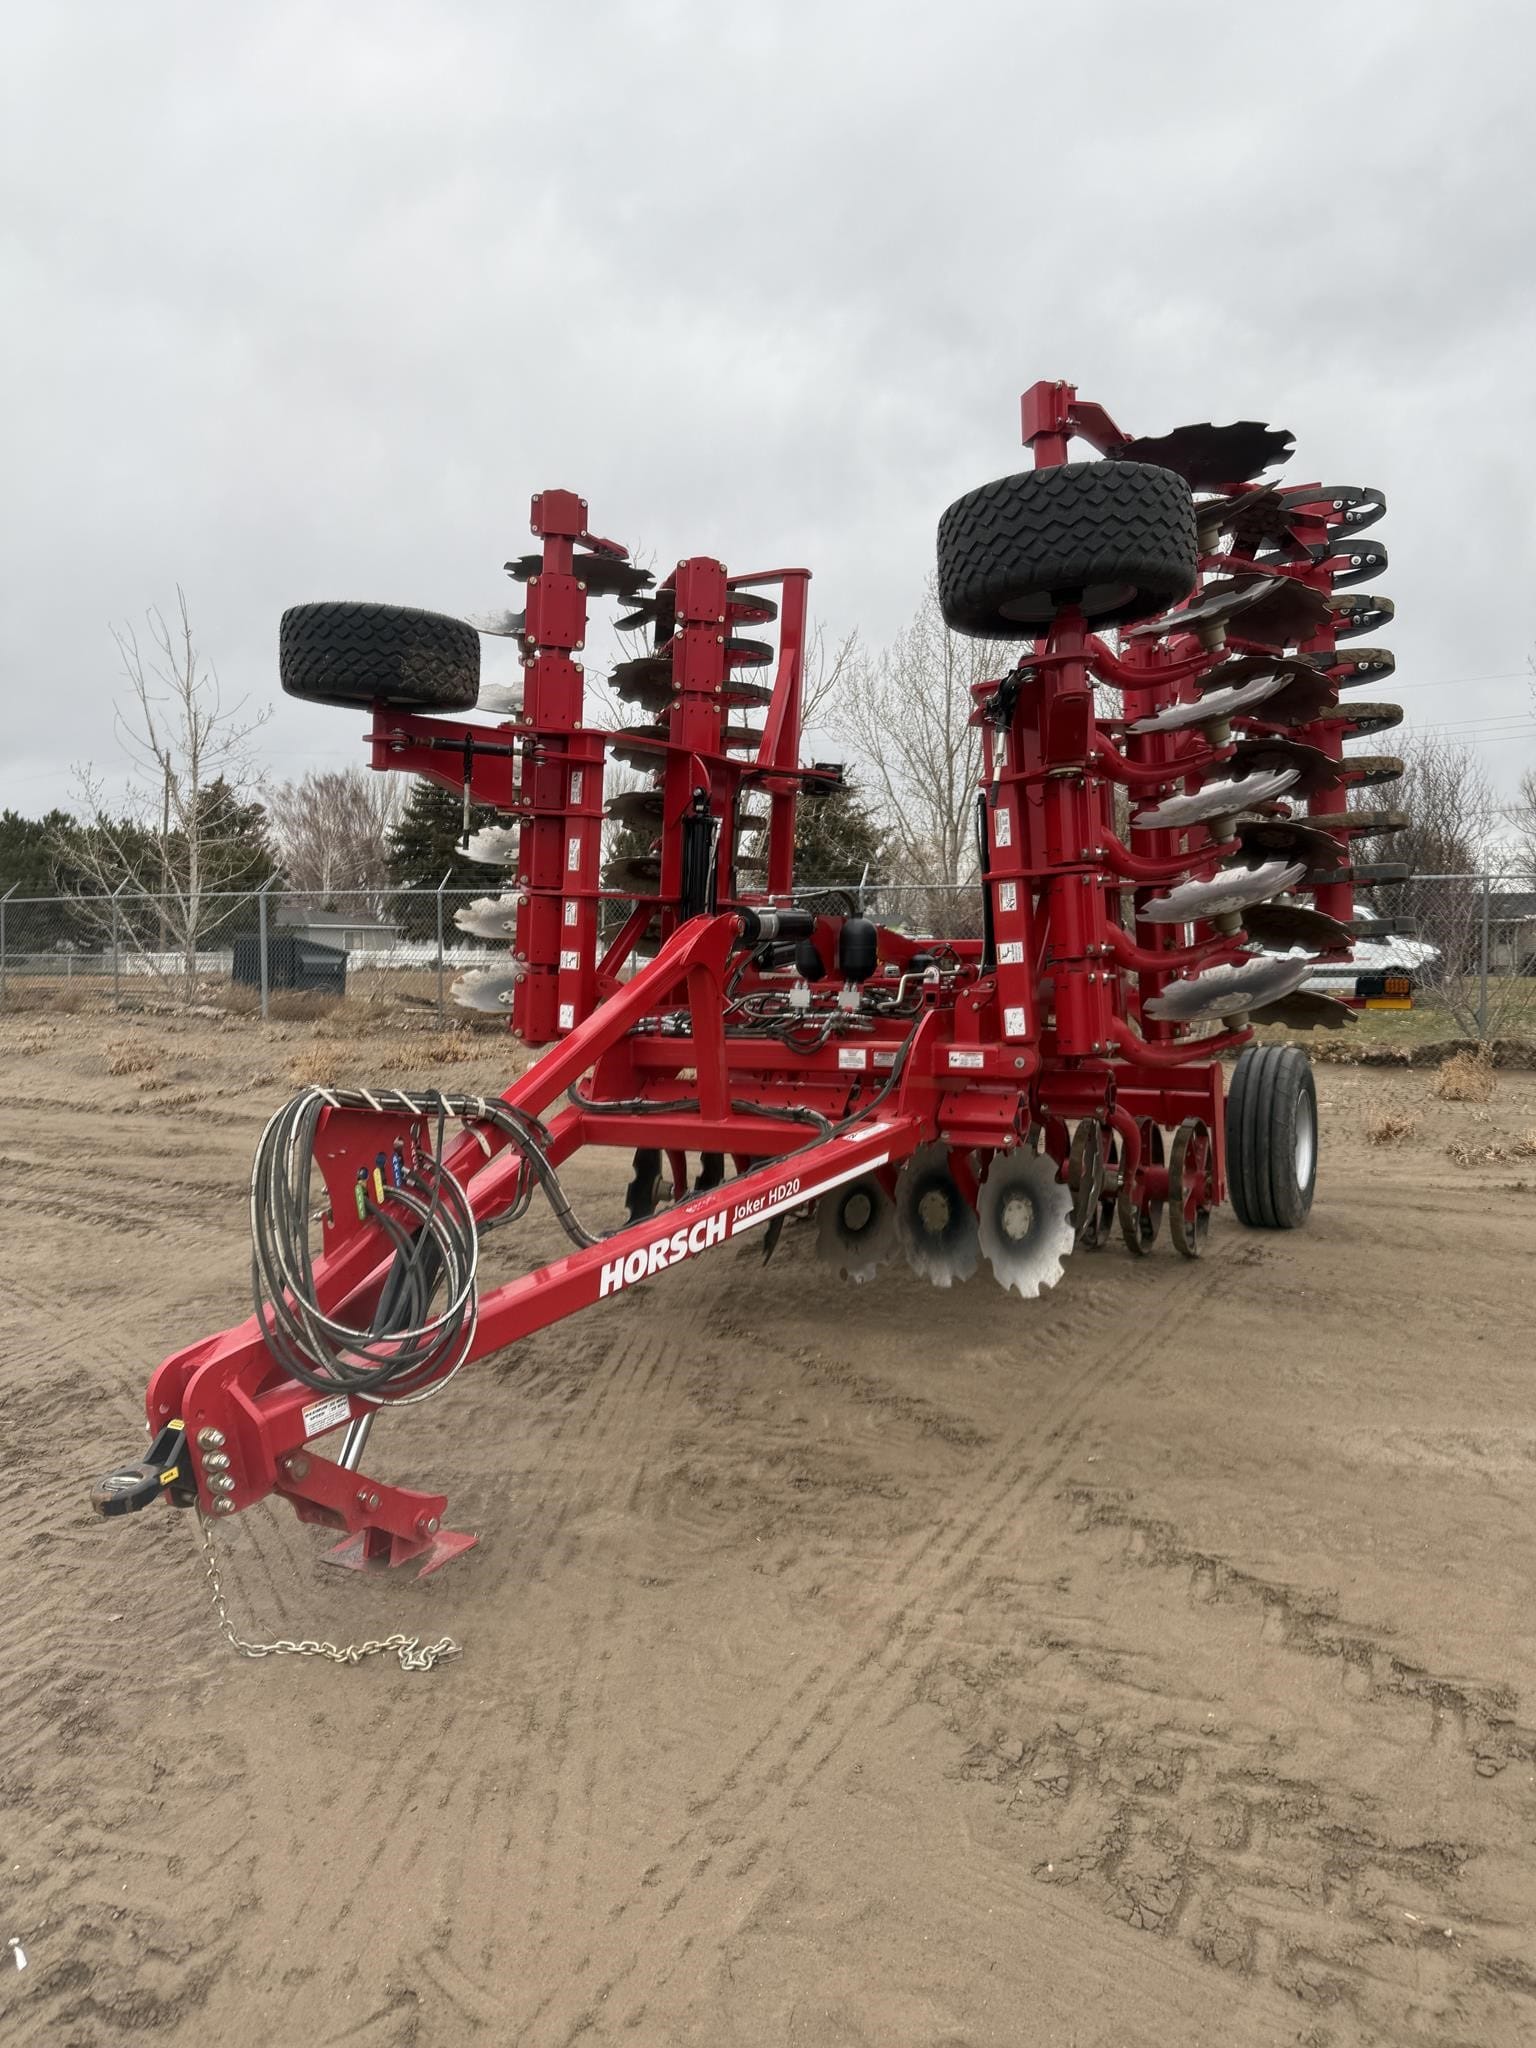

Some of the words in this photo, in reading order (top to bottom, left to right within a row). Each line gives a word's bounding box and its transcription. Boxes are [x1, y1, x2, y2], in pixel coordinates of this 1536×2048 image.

[732, 1199, 766, 1222] Joker
[768, 1178, 800, 1205] HD20
[600, 1210, 728, 1298] HORSCH
